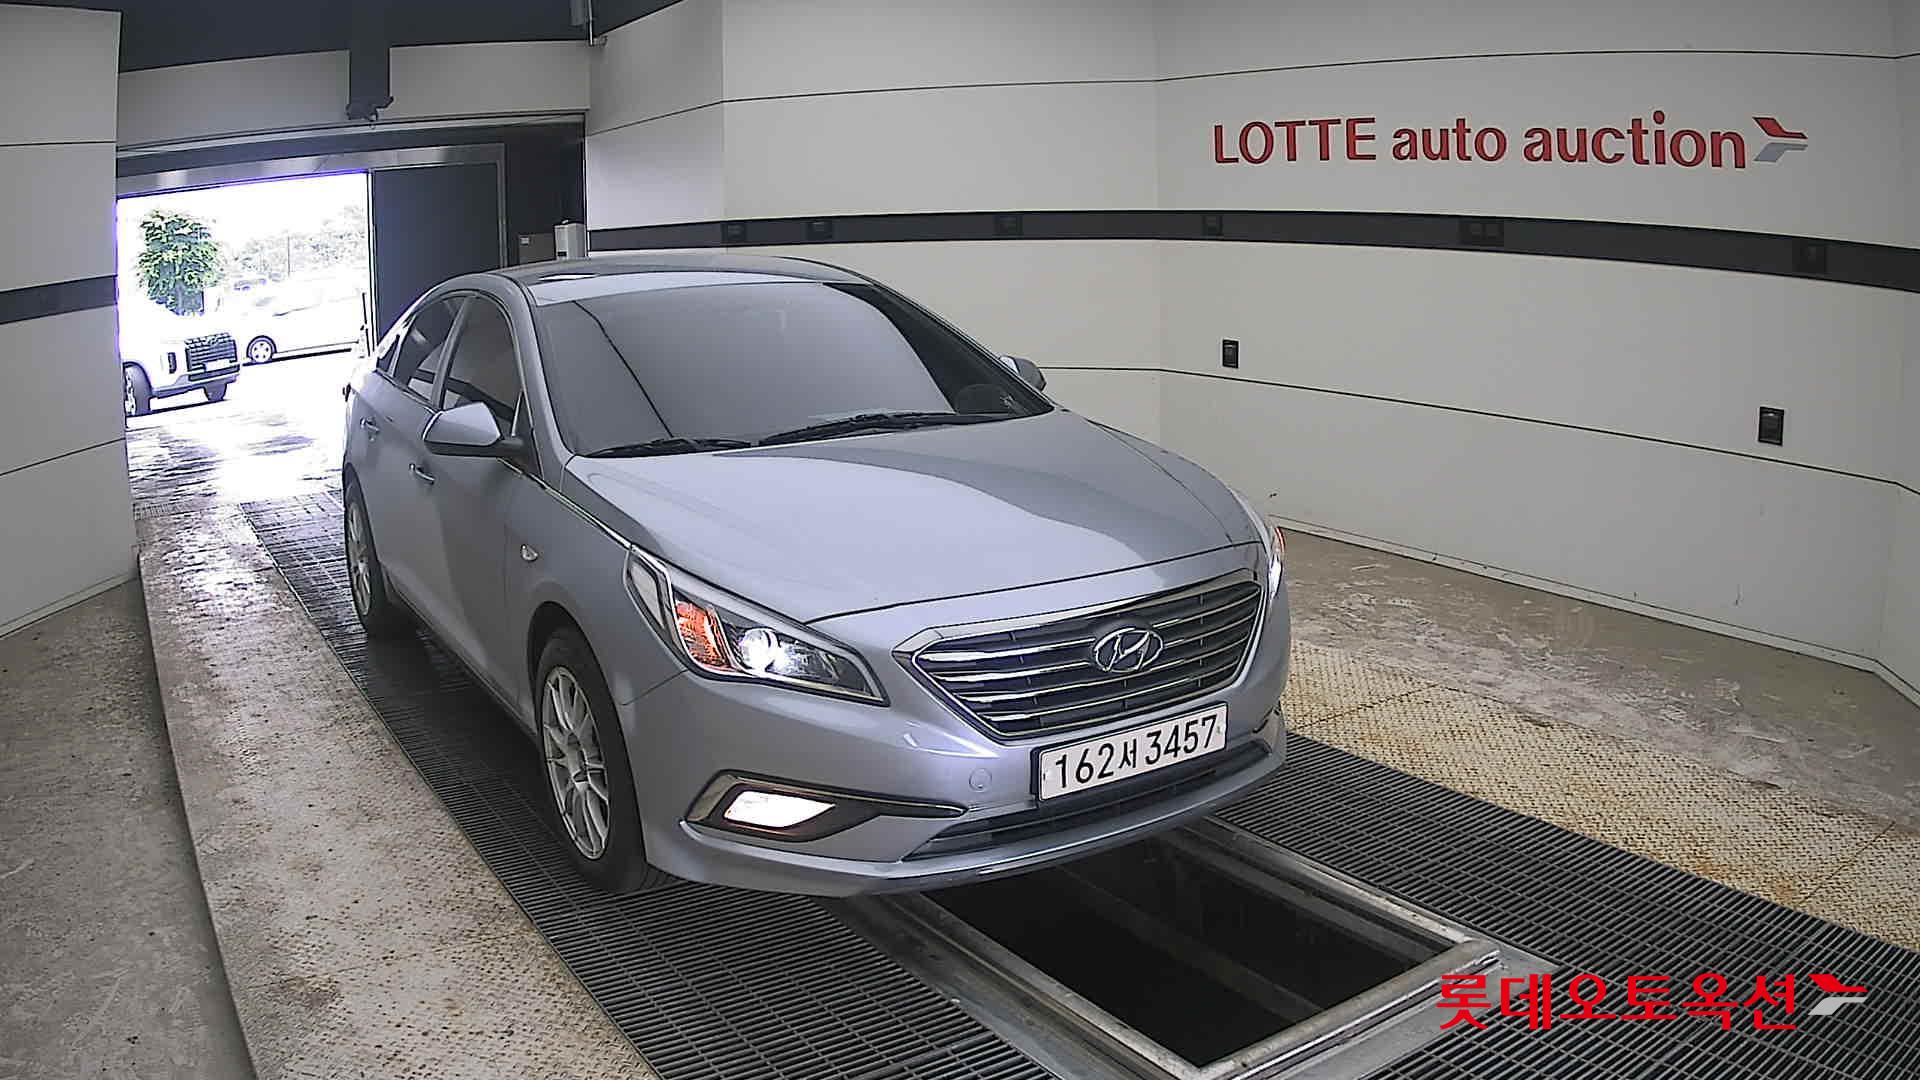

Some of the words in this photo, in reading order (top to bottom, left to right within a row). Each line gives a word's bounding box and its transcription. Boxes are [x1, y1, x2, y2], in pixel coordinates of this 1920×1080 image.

[1214, 117, 1377, 164] LOTTE
[1393, 119, 1508, 163] auto
[1522, 111, 1747, 169] auction
